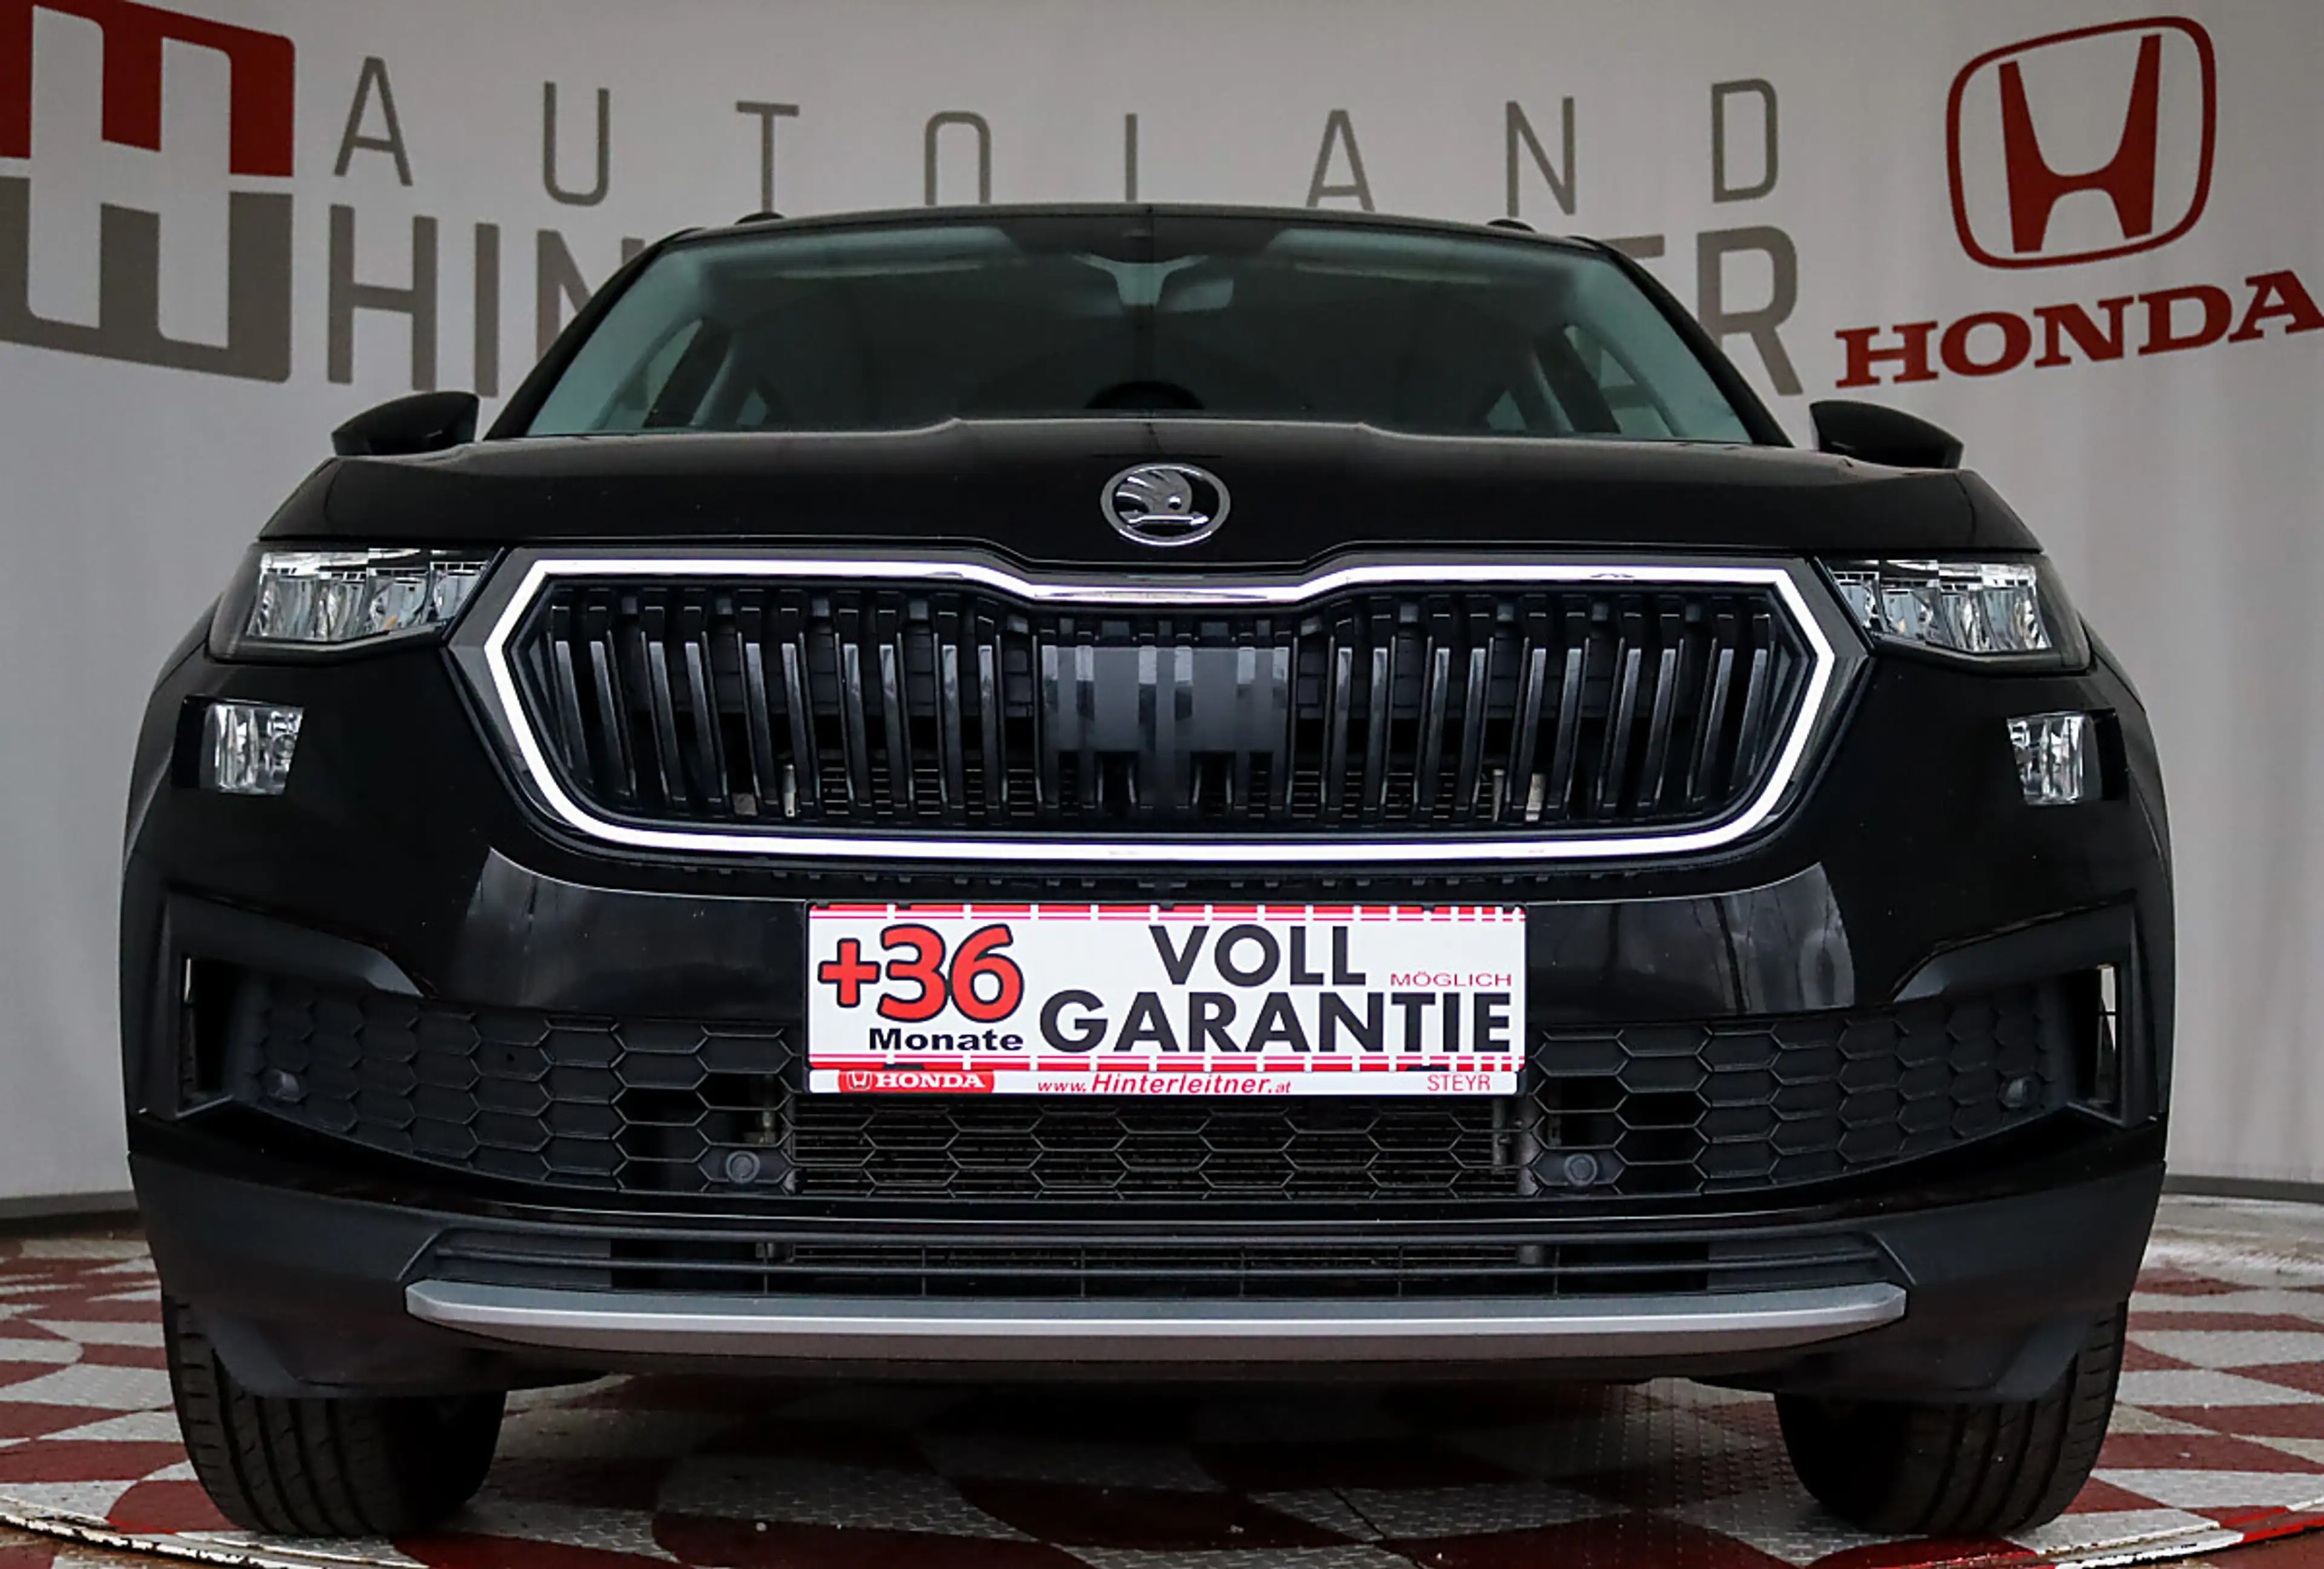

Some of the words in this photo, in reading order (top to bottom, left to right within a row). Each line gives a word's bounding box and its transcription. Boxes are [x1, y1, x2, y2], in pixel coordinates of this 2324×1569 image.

[1835, 269, 2324, 388] HONDA
[818, 924, 1025, 1023] +36
[1149, 924, 1366, 987] VOLL
[1390, 971, 1512, 987] MÖGLICH
[869, 1028, 1024, 1051] Monate
[1039, 989, 1511, 1053] GARANTIE
[875, 1073, 985, 1088] HONDA
[1426, 1073, 1491, 1092] STEYR
